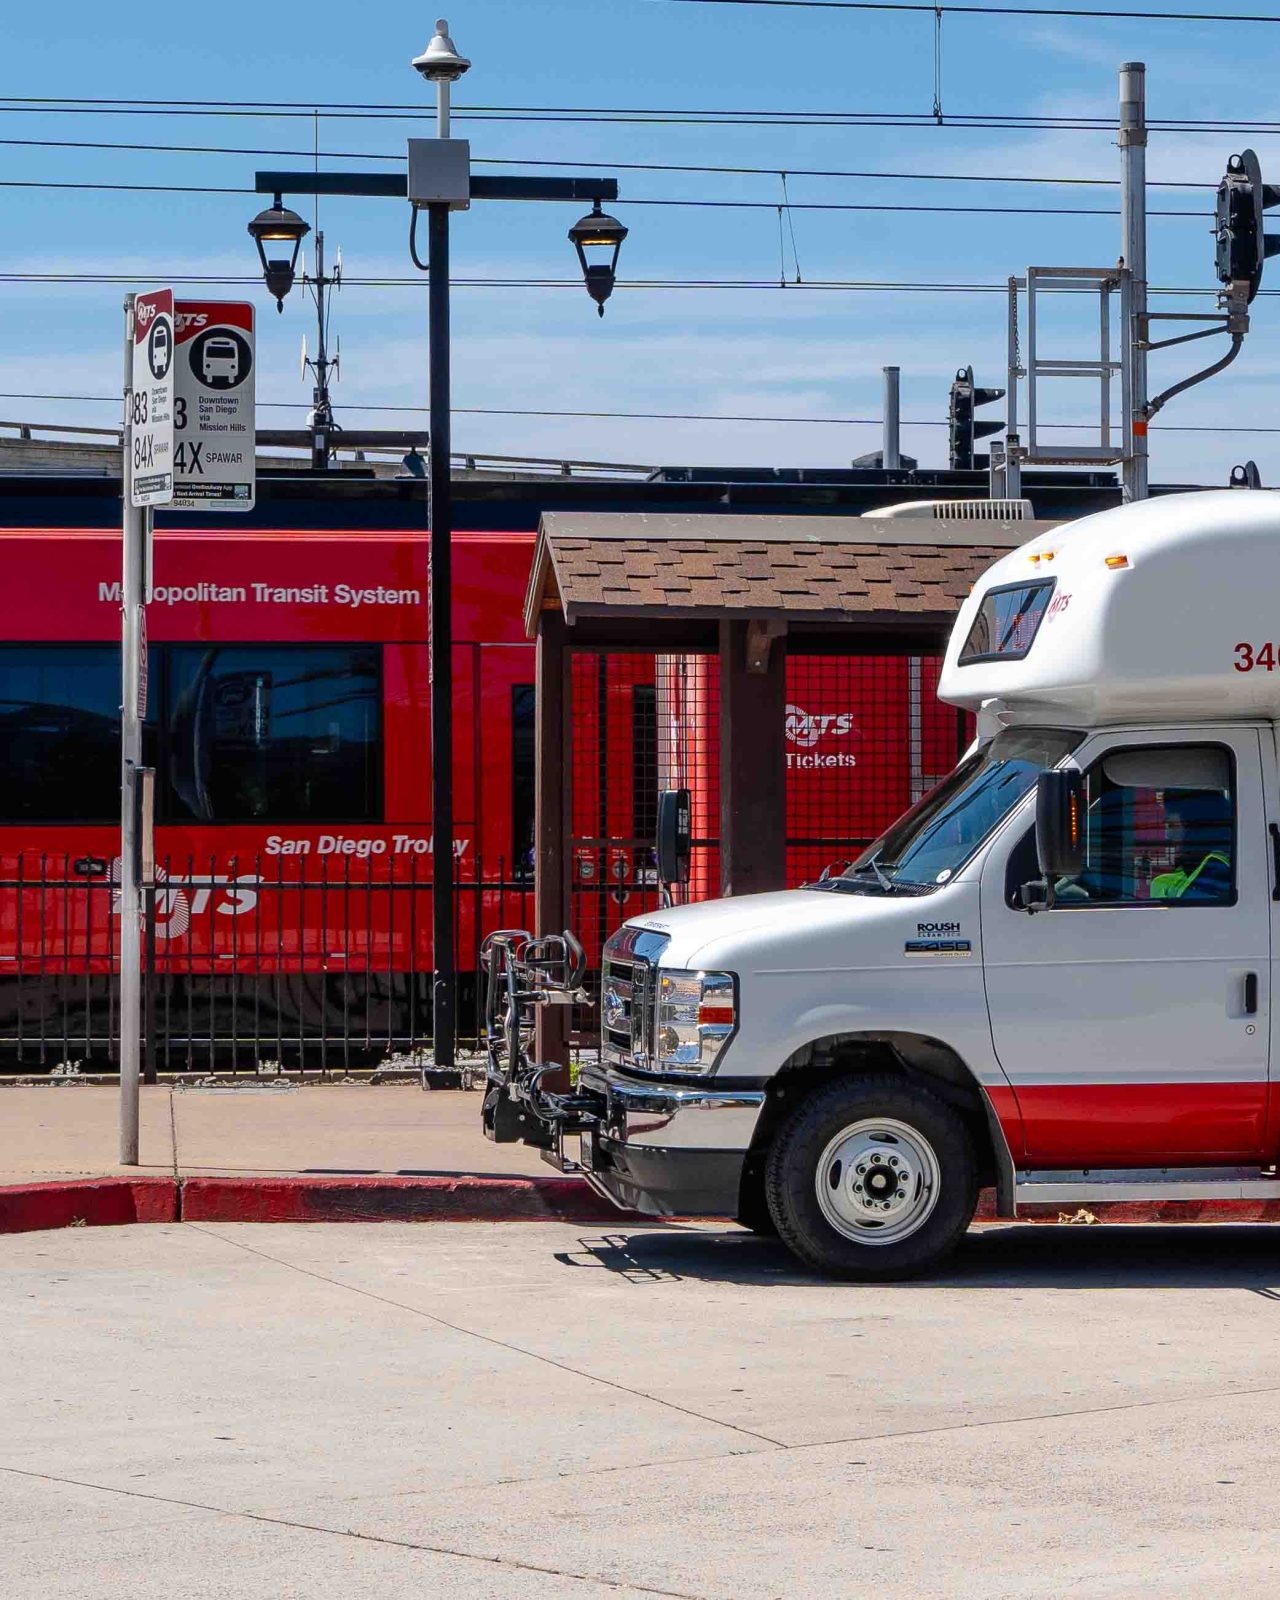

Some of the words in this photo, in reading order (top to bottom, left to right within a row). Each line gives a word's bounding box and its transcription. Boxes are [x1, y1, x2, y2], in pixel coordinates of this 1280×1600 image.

[134, 391, 148, 425] 83
[199, 396, 239, 405] Downtown
[199, 405, 213, 413] San
[216, 405, 237, 414] Diego
[174, 397, 188, 430] 3
[200, 423, 228, 432] Mission
[229, 423, 246, 432] Hills
[134, 434, 154, 470] 84X
[174, 442, 204, 474] 4X
[206, 453, 243, 463] SPAWAR
[98, 582, 246, 606] Mopolitan
[251, 583, 328, 604] Transit
[334, 584, 420, 607] System
[1048, 593, 1072, 613] MTS
[785, 714, 854, 735] MTS
[786, 752, 856, 768] Tickets
[266, 836, 310, 855] San
[317, 836, 386, 858] Diego
[392, 835, 470, 857] Troly
[917, 922, 960, 931] ROUSH
